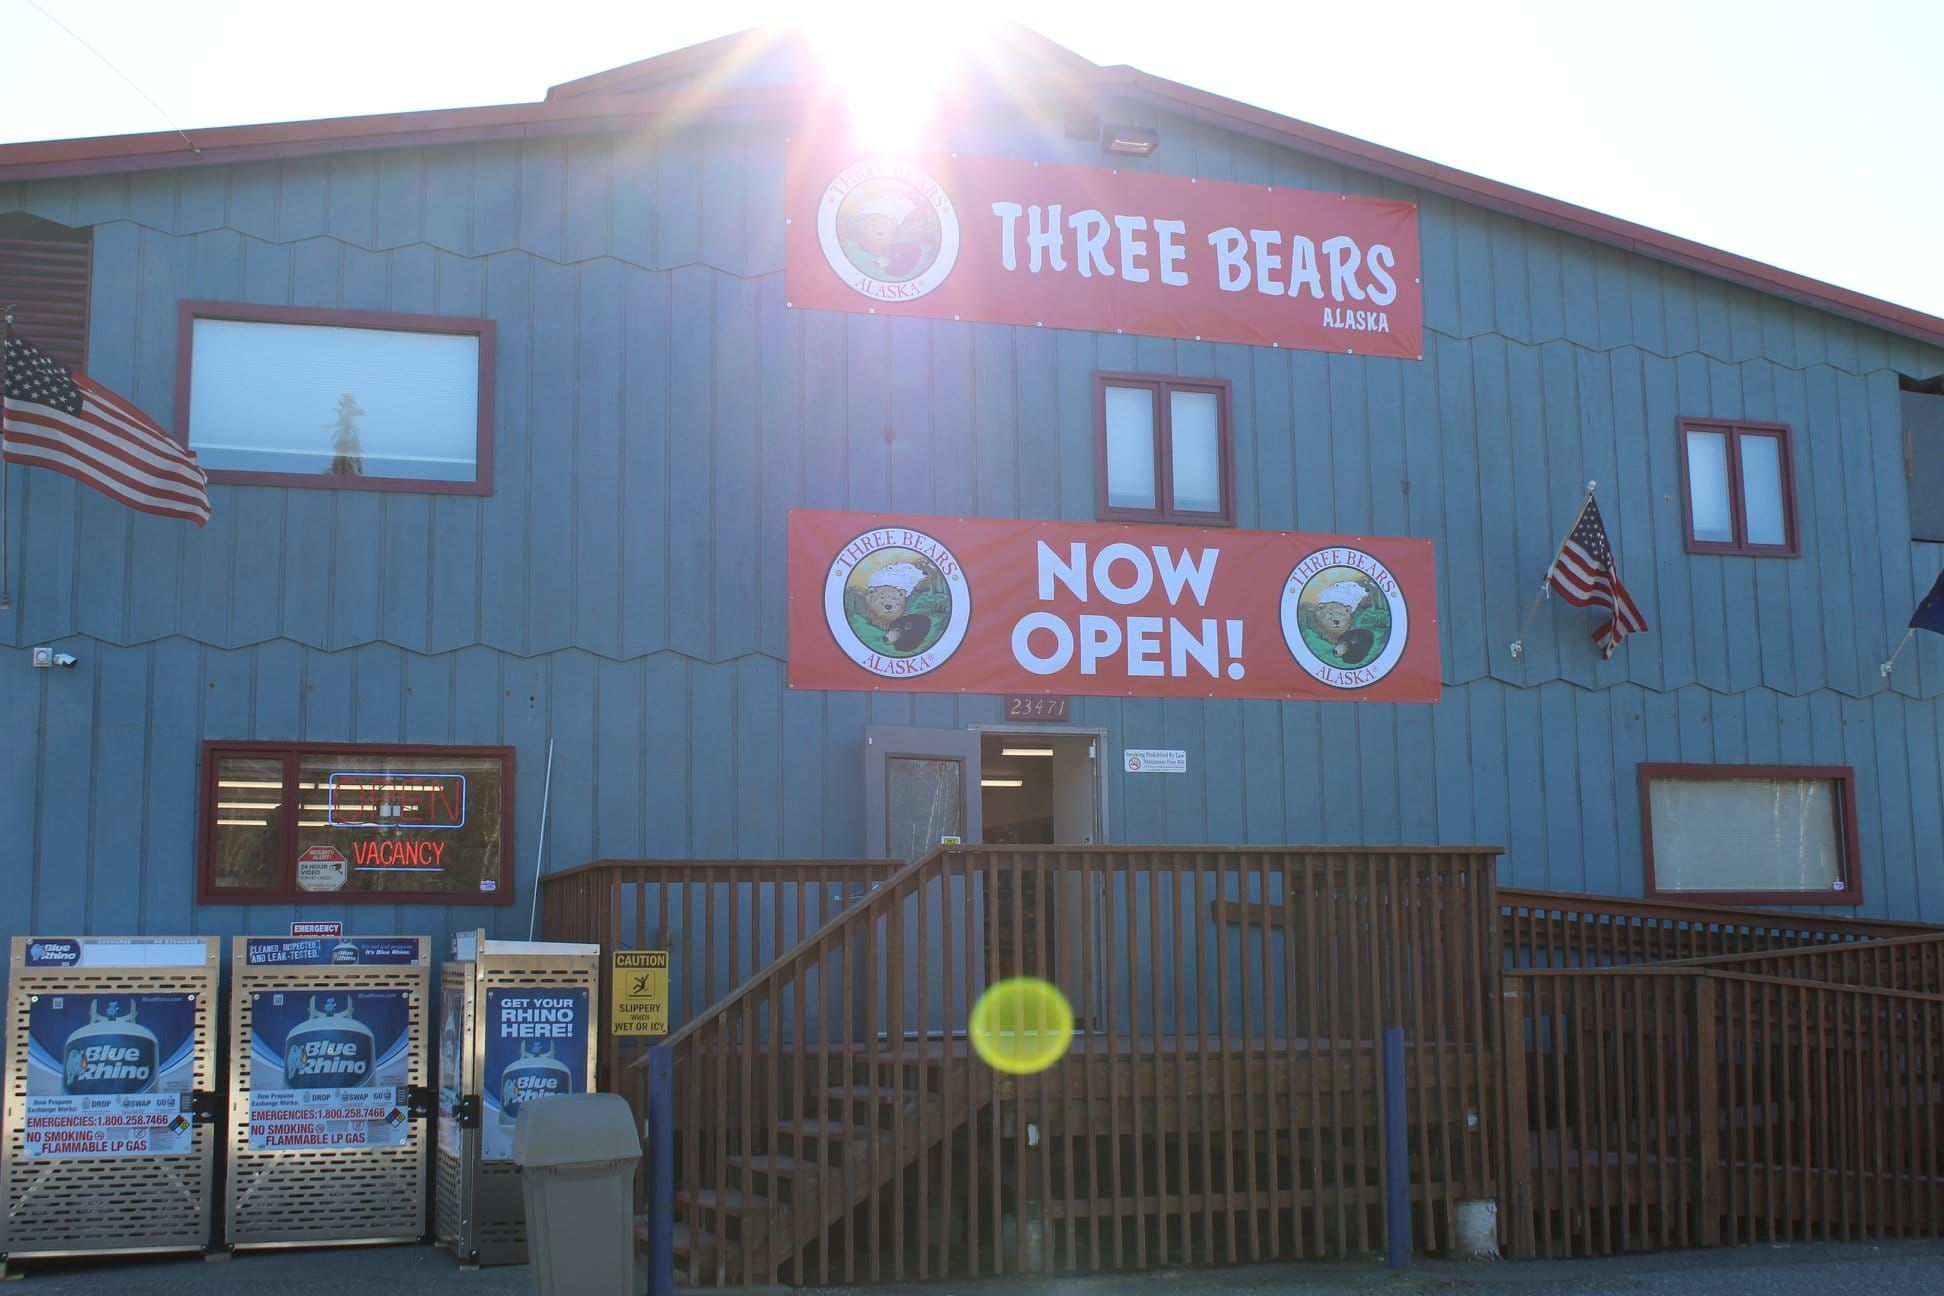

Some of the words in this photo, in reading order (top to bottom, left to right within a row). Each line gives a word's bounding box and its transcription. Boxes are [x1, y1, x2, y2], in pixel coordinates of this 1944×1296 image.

[992, 201, 1189, 286] THREE
[1208, 226, 1397, 306] BEARS
[856, 277, 921, 299] ALASKA
[1323, 307, 1390, 333] ALASKA
[836, 530, 897, 570] THREE
[902, 531, 959, 576] BEARS
[1036, 540, 1220, 607] NOW
[1290, 549, 1341, 587] THREE
[1346, 550, 1397, 593] BEARS
[1011, 612, 1245, 680] OPEN!
[1010, 698, 1065, 715] 23471
[333, 777, 461, 823] OPEN
[353, 839, 446, 866] VACANCY
[294, 924, 340, 933] EMERGENCY
[43, 943, 72, 953] Blue
[41, 951, 77, 961] Rhino
[616, 955, 665, 966] CAUTION
[501, 998, 530, 1008] GET
[534, 998, 574, 1008] YOUR
[619, 1003, 661, 1013] SLIPPERY
[501, 1008, 574, 1022] RHINO
[501, 1023, 573, 1038] HERE!
[614, 1022, 634, 1031] WET
[635, 1022, 648, 1031] OR
[650, 1022, 665, 1031] ICY
[85, 1045, 140, 1062] Blue
[305, 1040, 356, 1056] Blue
[78, 1061, 149, 1081] Rhino
[300, 1056, 367, 1075] Rhino
[517, 1076, 558, 1089] Blue
[131, 1099, 152, 1107] SWAP
[312, 1094, 331, 1102] DROP
[349, 1093, 369, 1101] SWAP
[373, 1092, 383, 1100] GO
[91, 1100, 112, 1108] DROP
[26, 1131, 41, 1143] NO
[44, 1130, 93, 1143] SMOKING
[250, 1124, 265, 1136] NO
[267, 1123, 315, 1135] SMOKING
[265, 1134, 329, 1146] FLAMMABLE
[331, 1133, 344, 1144] LP
[345, 1132, 366, 1144] GAS
[42, 1141, 108, 1154] FLAMMABLE
[111, 1141, 124, 1152] LP
[126, 1140, 148, 1151] GAS
